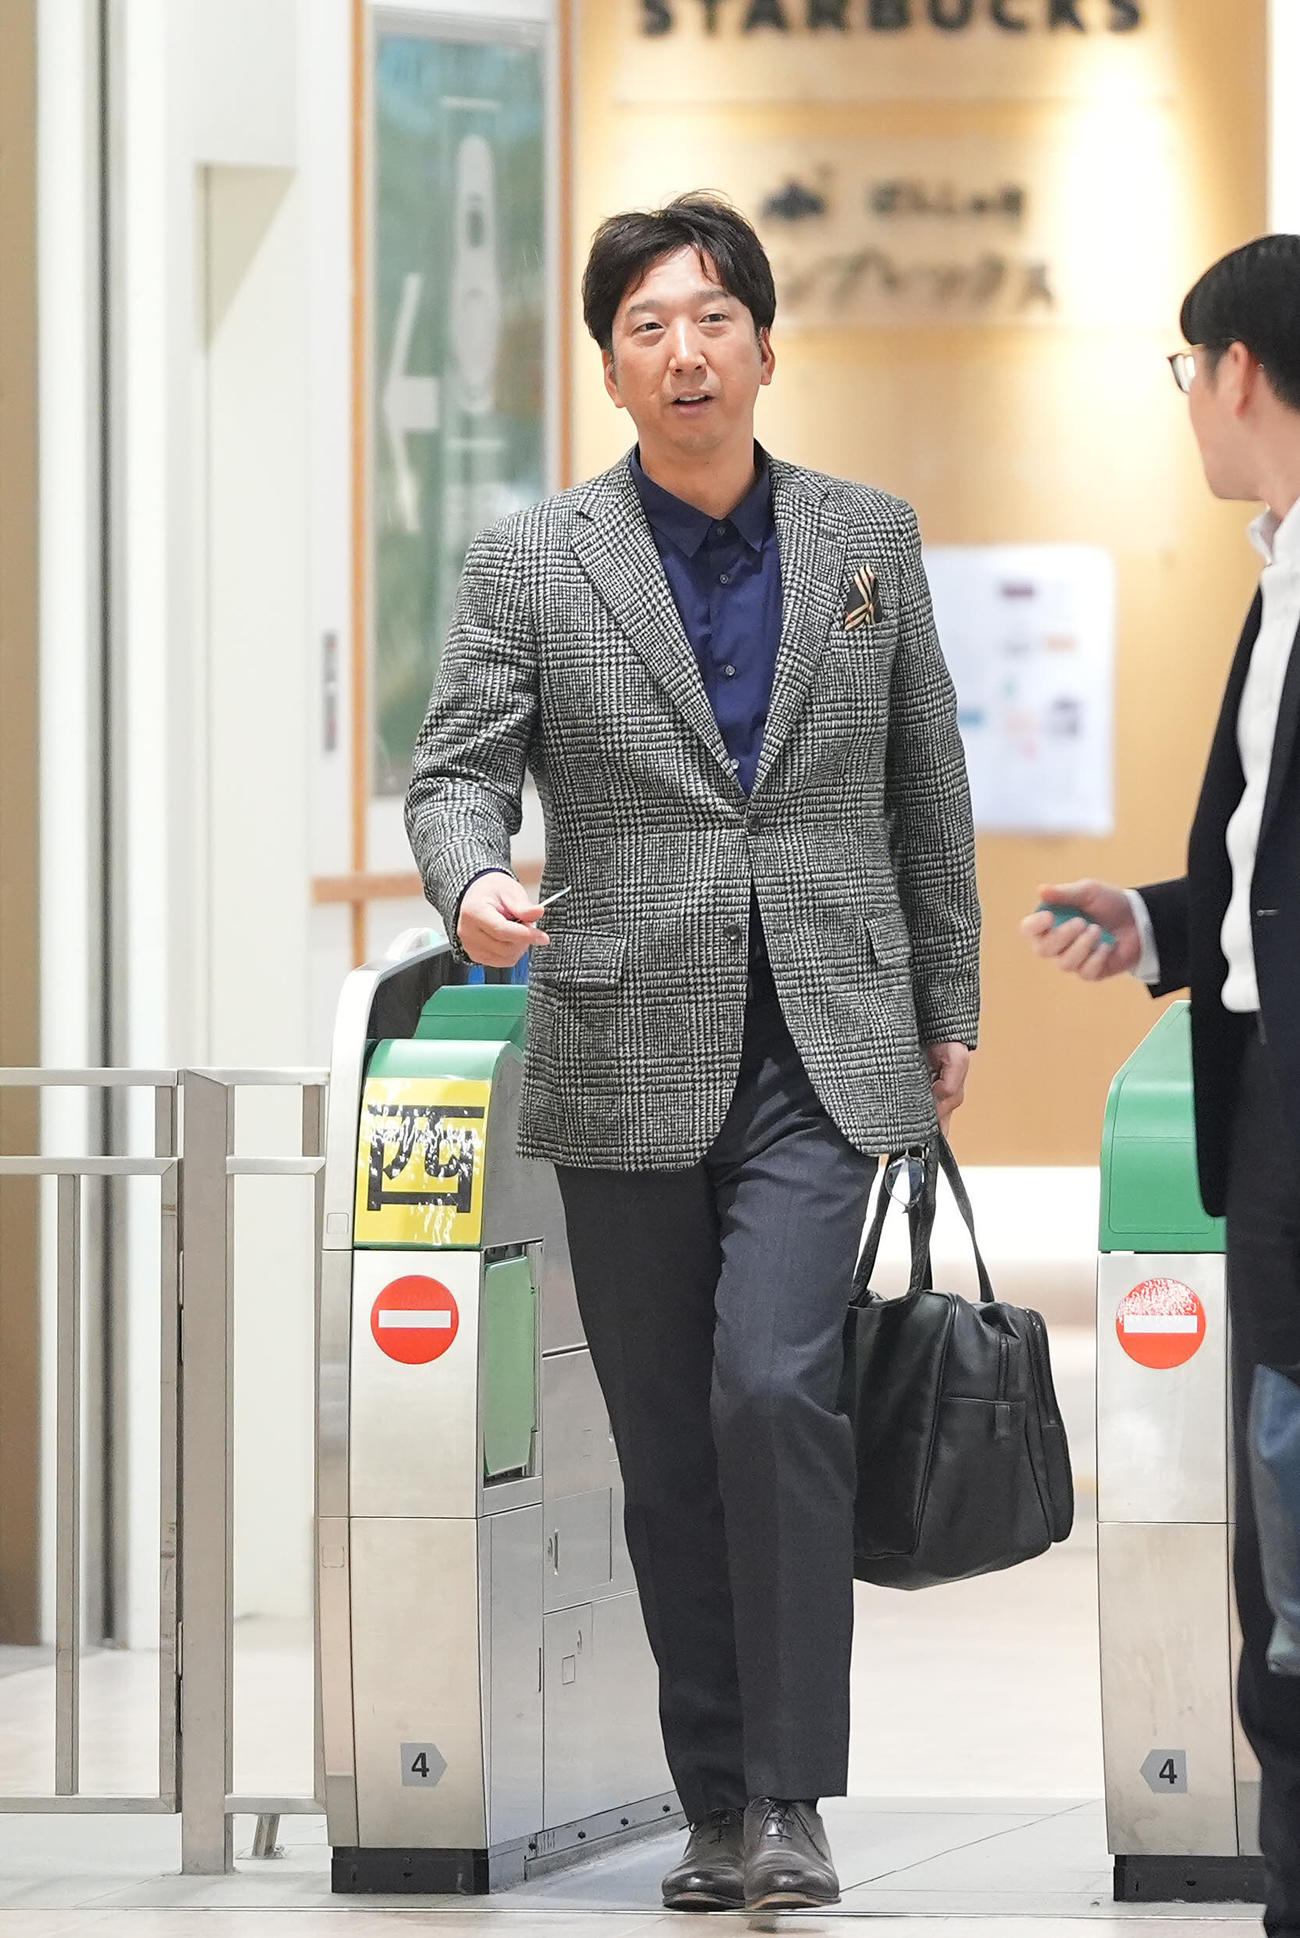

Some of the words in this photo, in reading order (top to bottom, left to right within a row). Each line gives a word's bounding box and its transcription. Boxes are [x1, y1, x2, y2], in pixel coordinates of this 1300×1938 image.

[641, 0, 1142, 34] STARBUCKS
[411, 1752, 430, 1778] 4
[1159, 1758, 1178, 1784] 4
